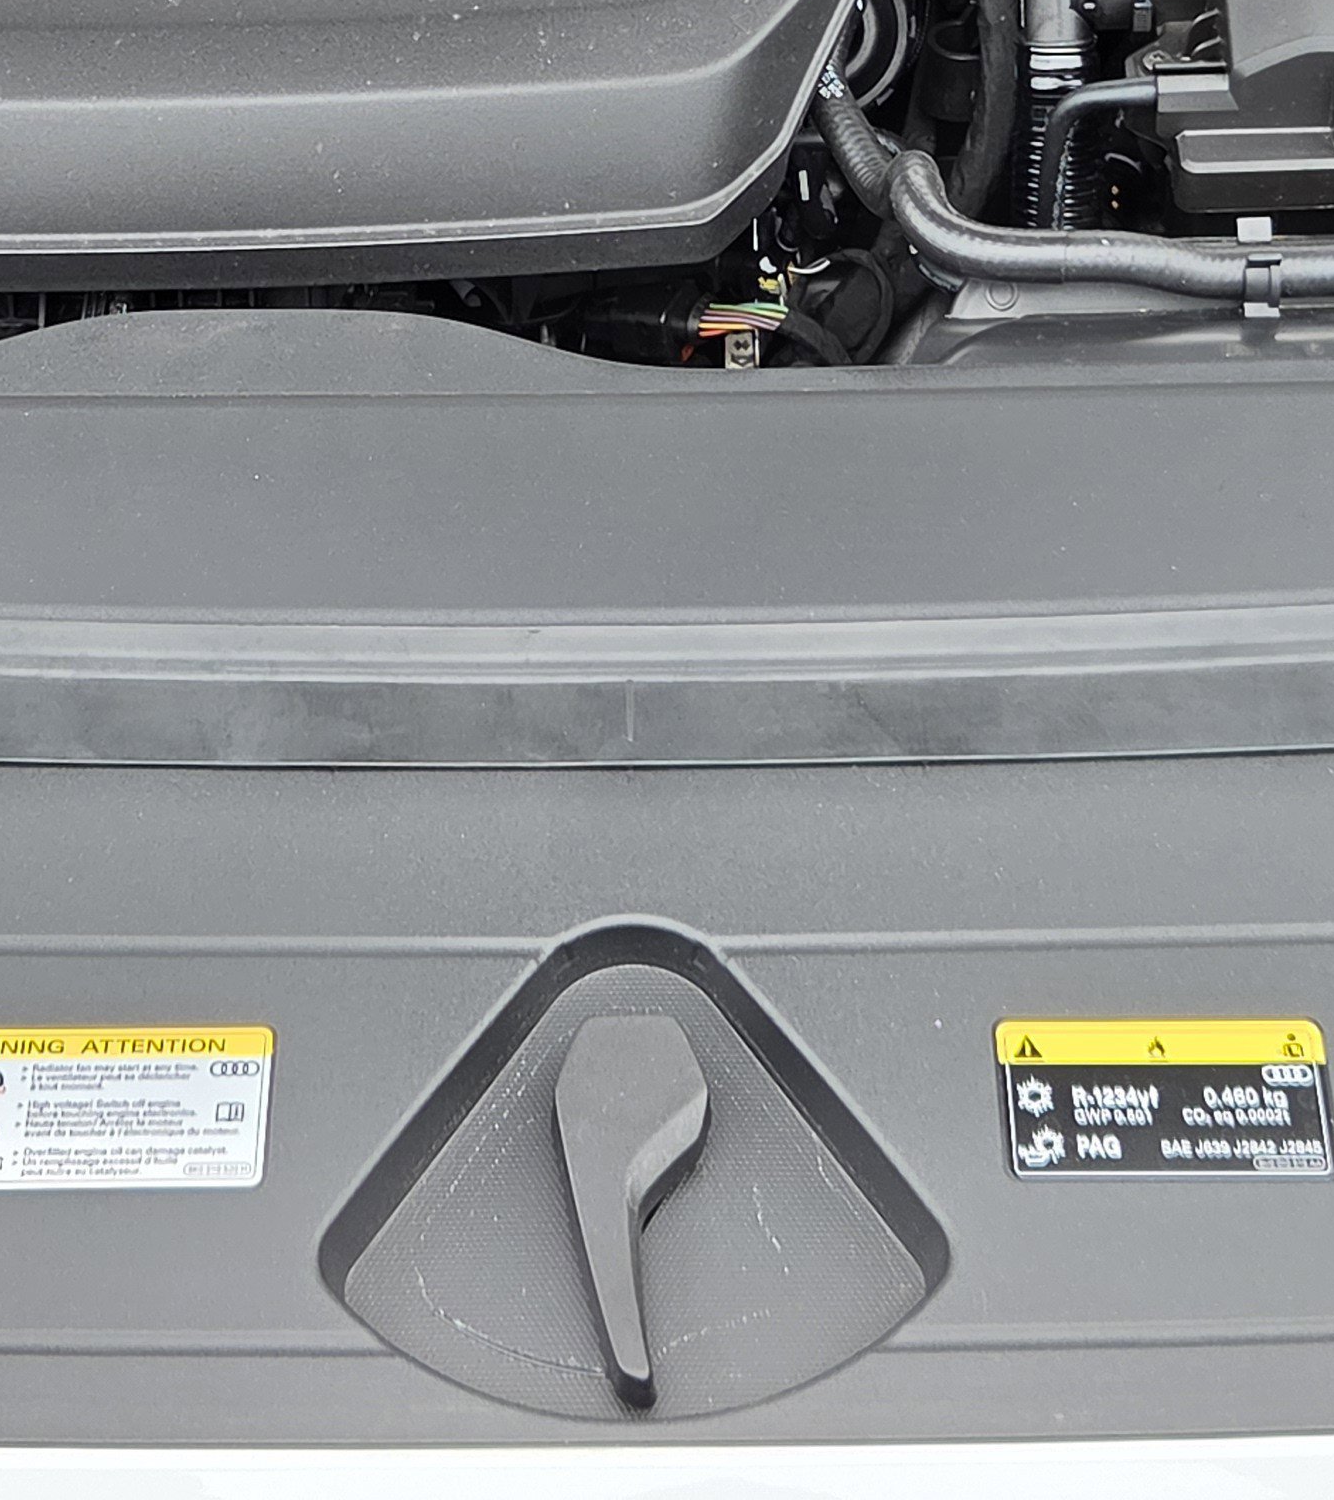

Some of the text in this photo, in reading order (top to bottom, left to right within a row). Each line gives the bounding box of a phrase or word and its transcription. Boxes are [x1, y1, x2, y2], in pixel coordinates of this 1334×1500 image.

[80, 1038, 227, 1054] ATTENTION
[1261, 1085, 1290, 1111] kg
[1076, 1133, 1122, 1160] PAG
[1160, 1137, 1193, 1159] SAE
